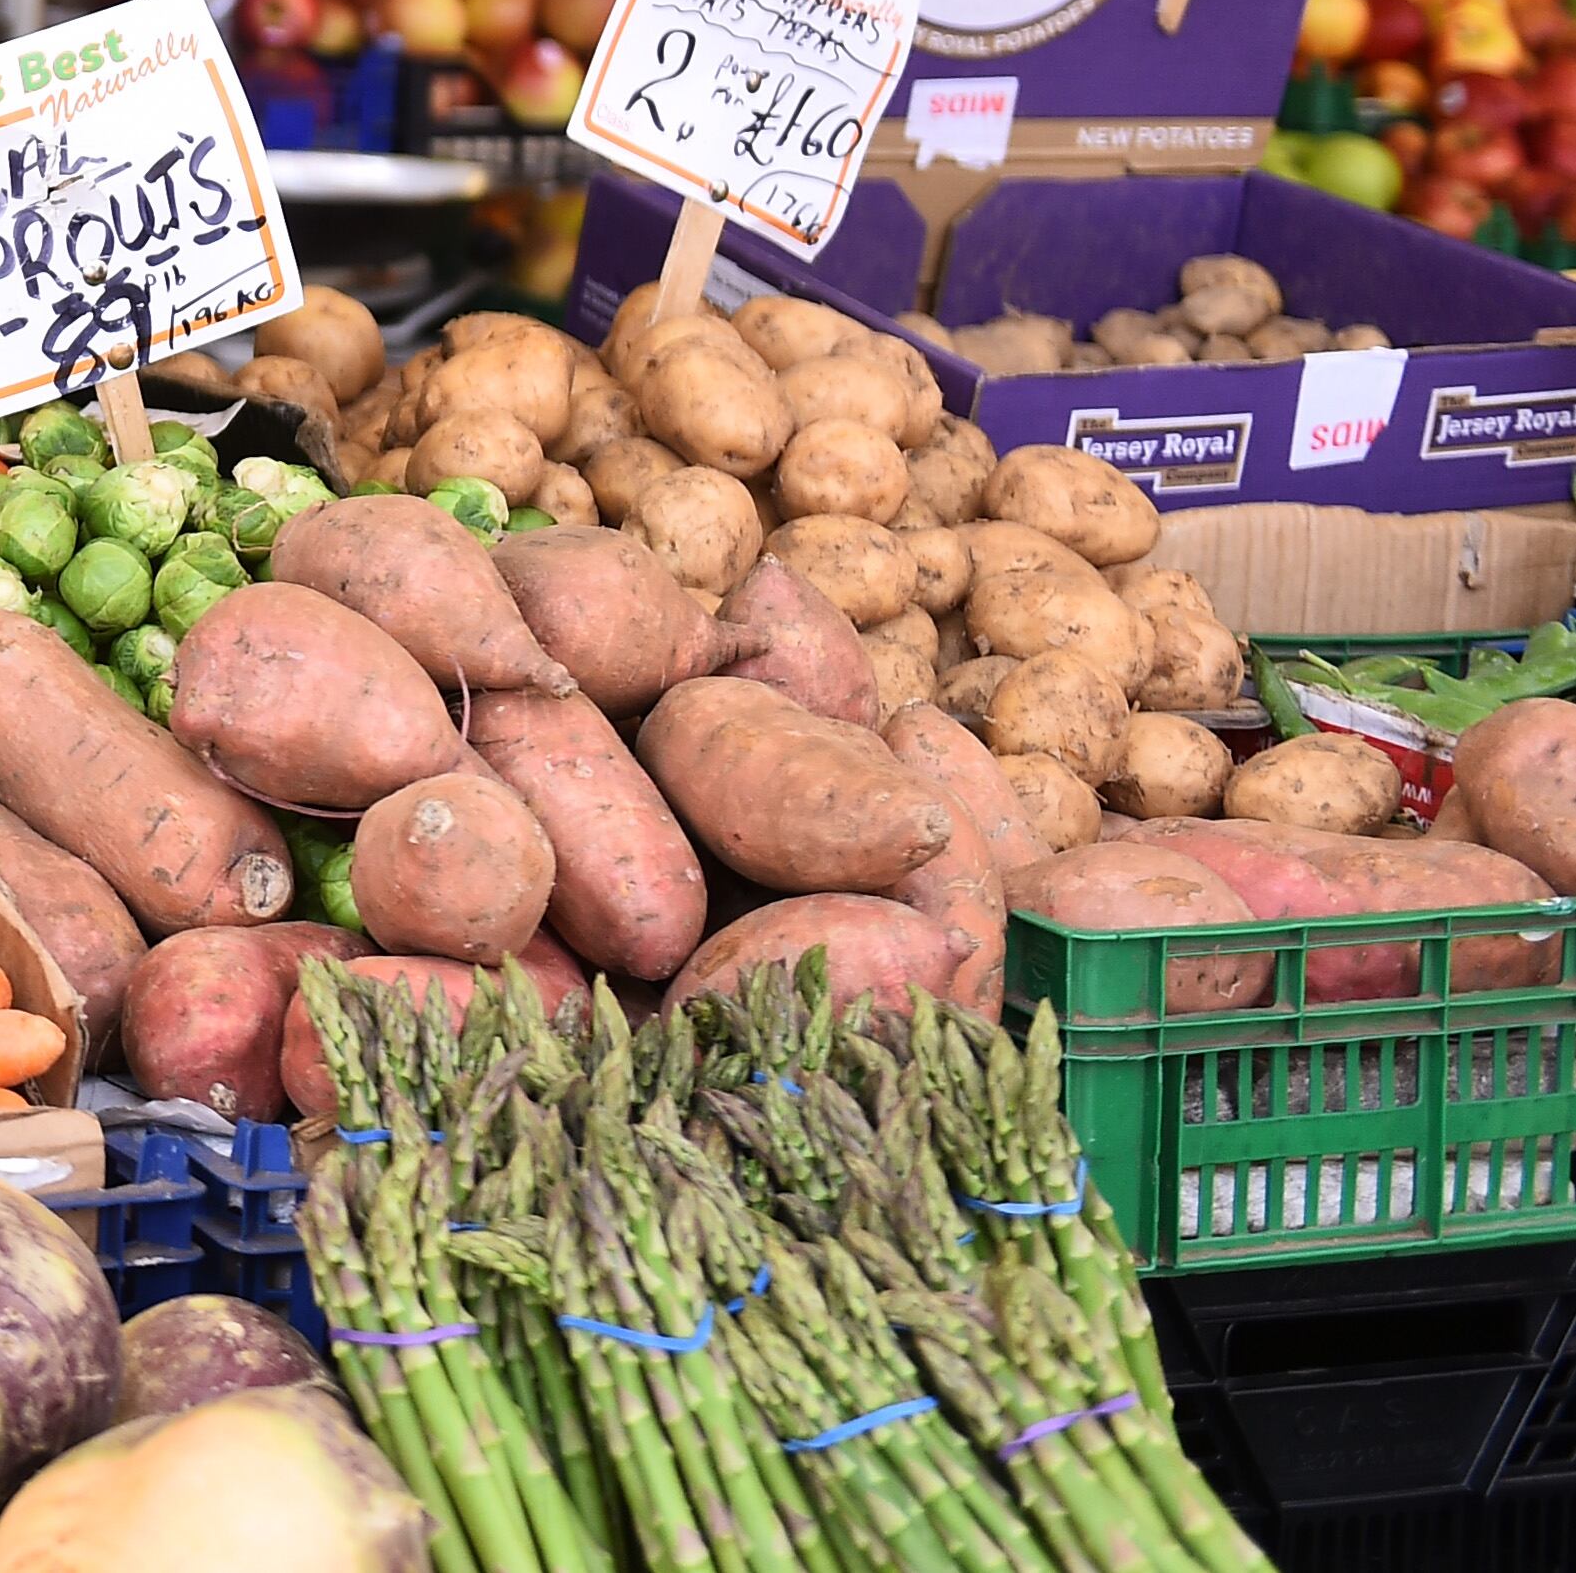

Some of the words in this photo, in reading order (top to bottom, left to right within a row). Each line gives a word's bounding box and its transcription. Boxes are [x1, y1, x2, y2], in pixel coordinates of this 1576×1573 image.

[18, 29, 129, 94] Best
[38, 30, 200, 127] Naturally
[1076, 126, 1129, 149] NEW
[1137, 125, 1255, 151] POTATOES
[1080, 436, 1159, 466] Jersey
[1161, 428, 1236, 463] Royal
[1436, 413, 1512, 444] Jersey
